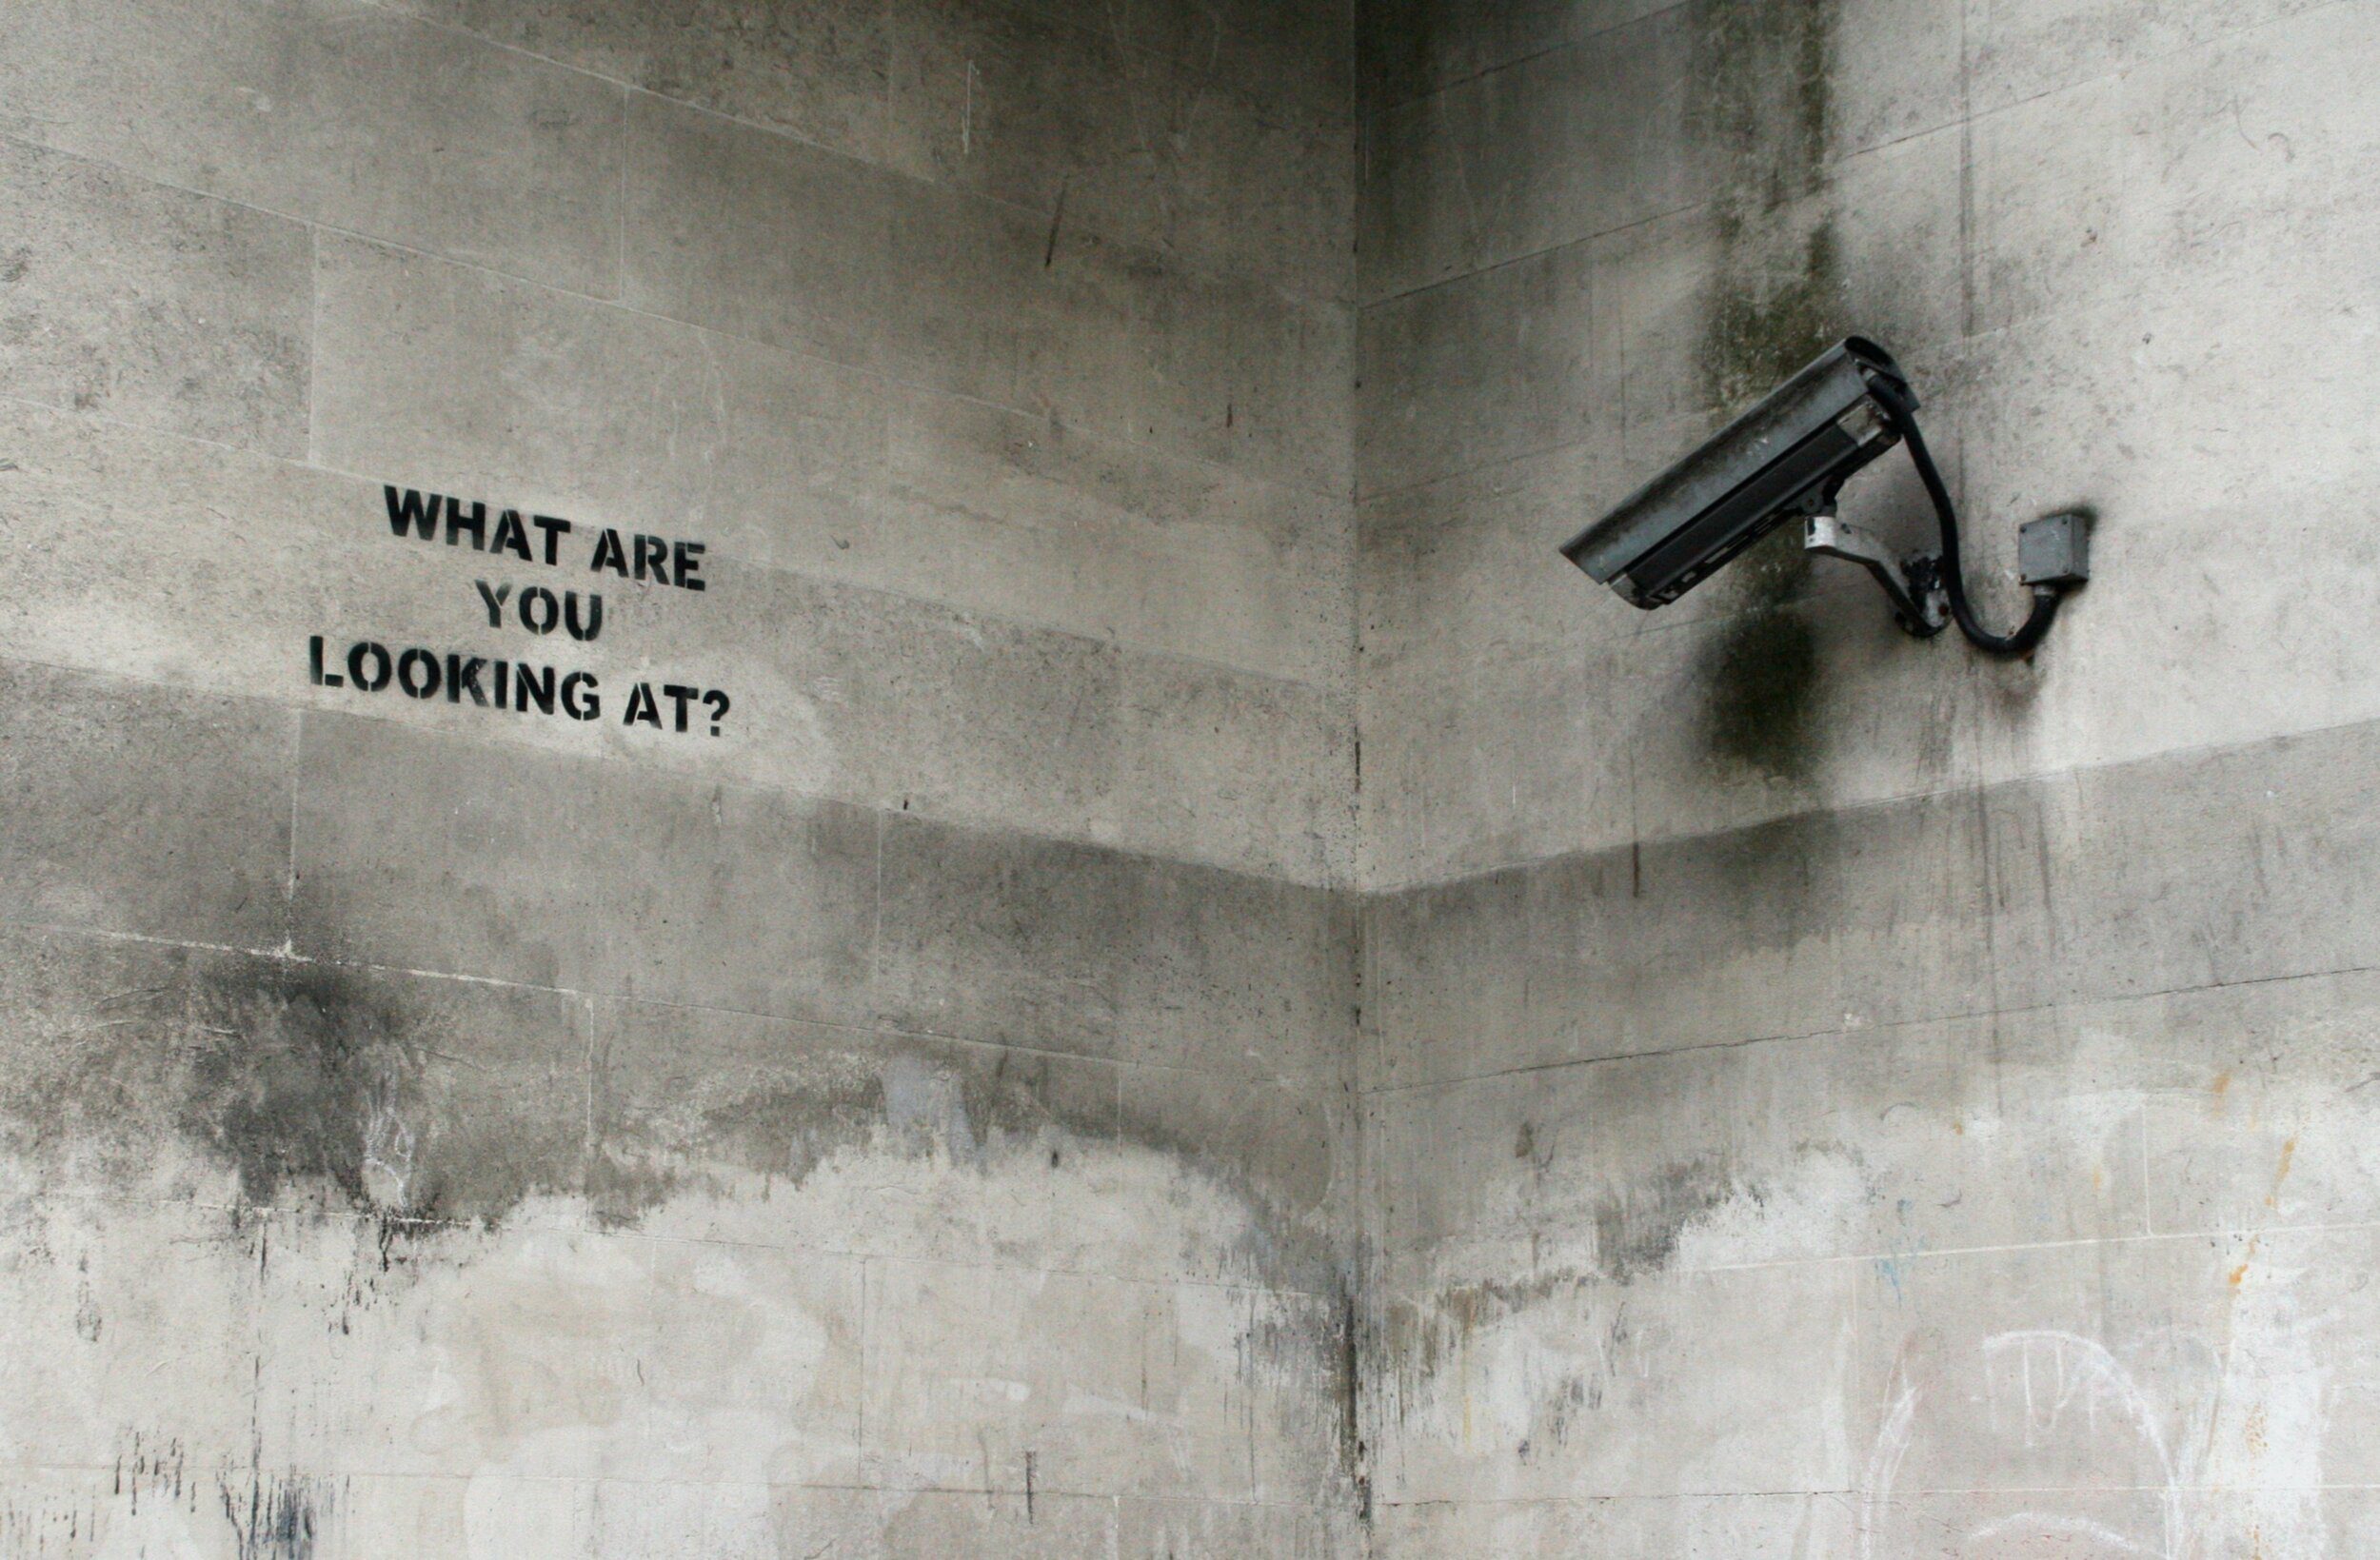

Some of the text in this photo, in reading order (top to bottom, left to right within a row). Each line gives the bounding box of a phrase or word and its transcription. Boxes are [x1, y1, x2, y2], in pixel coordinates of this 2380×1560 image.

[384, 484, 705, 592] WHAT ARE
[475, 579, 604, 642] YOU
[309, 635, 731, 737] LOOKING AT?
